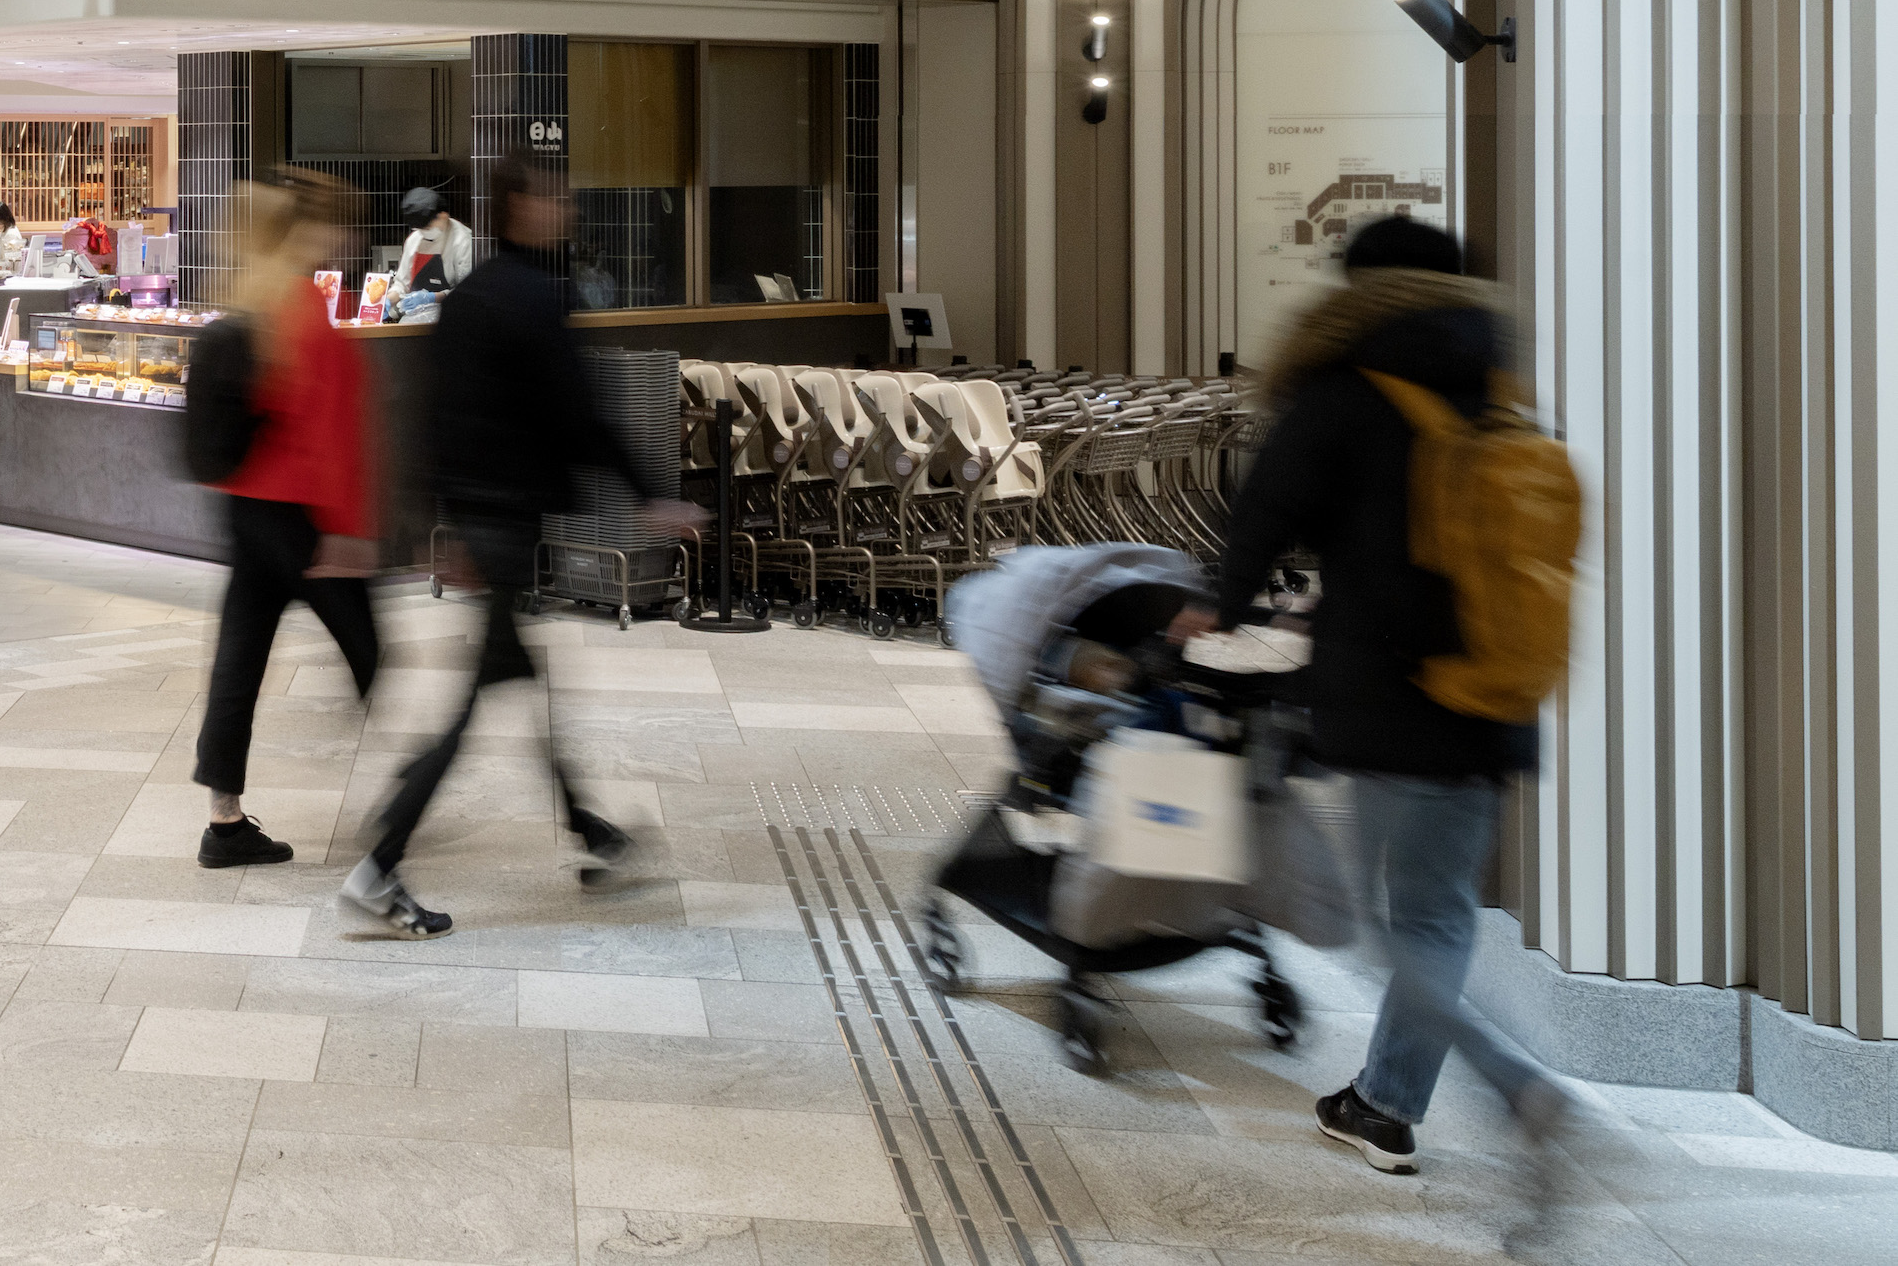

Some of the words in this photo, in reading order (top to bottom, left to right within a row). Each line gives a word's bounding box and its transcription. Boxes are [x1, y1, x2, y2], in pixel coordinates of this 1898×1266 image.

[529, 121, 562, 141] 日山
[1268, 126, 1301, 135] FLOOR
[1303, 126, 1325, 134] MAP
[1268, 162, 1292, 175] B1F
